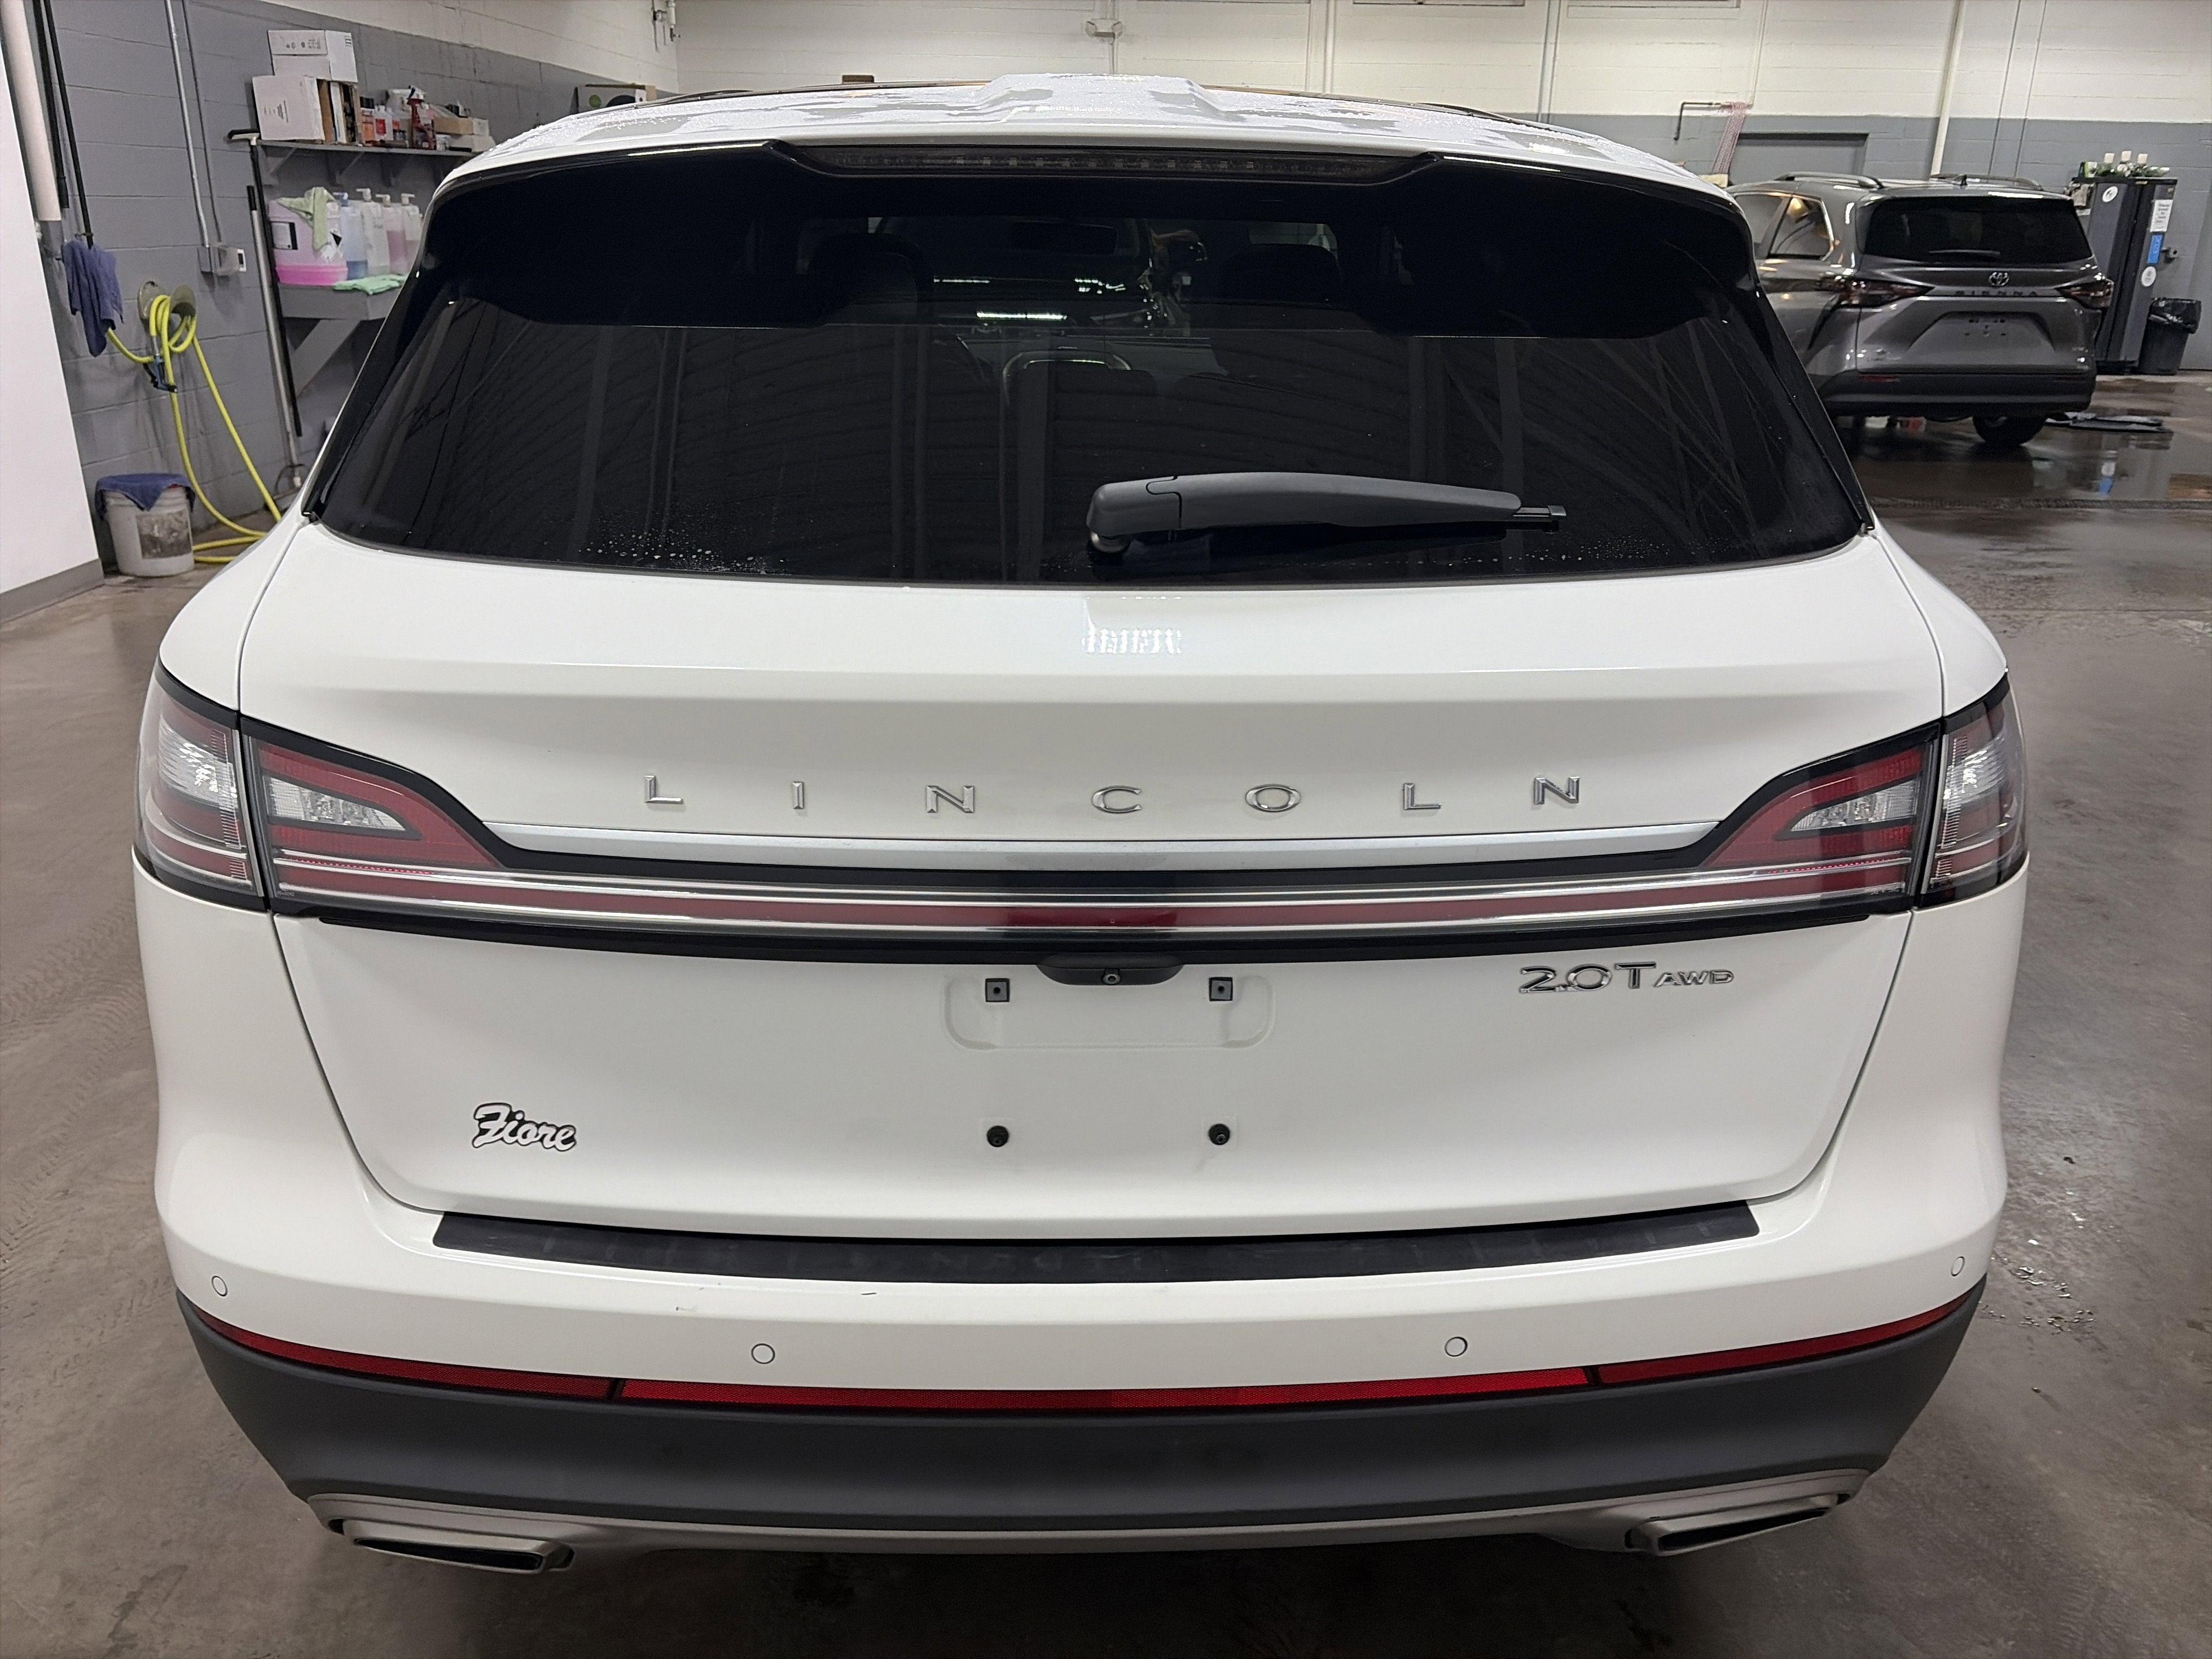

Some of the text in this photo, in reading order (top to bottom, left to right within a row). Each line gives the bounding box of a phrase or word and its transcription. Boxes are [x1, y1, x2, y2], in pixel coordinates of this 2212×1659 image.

[644, 774, 1581, 814] LINCOLN
[1655, 969, 1734, 988] AWD
[472, 1103, 577, 1152] Fiore
